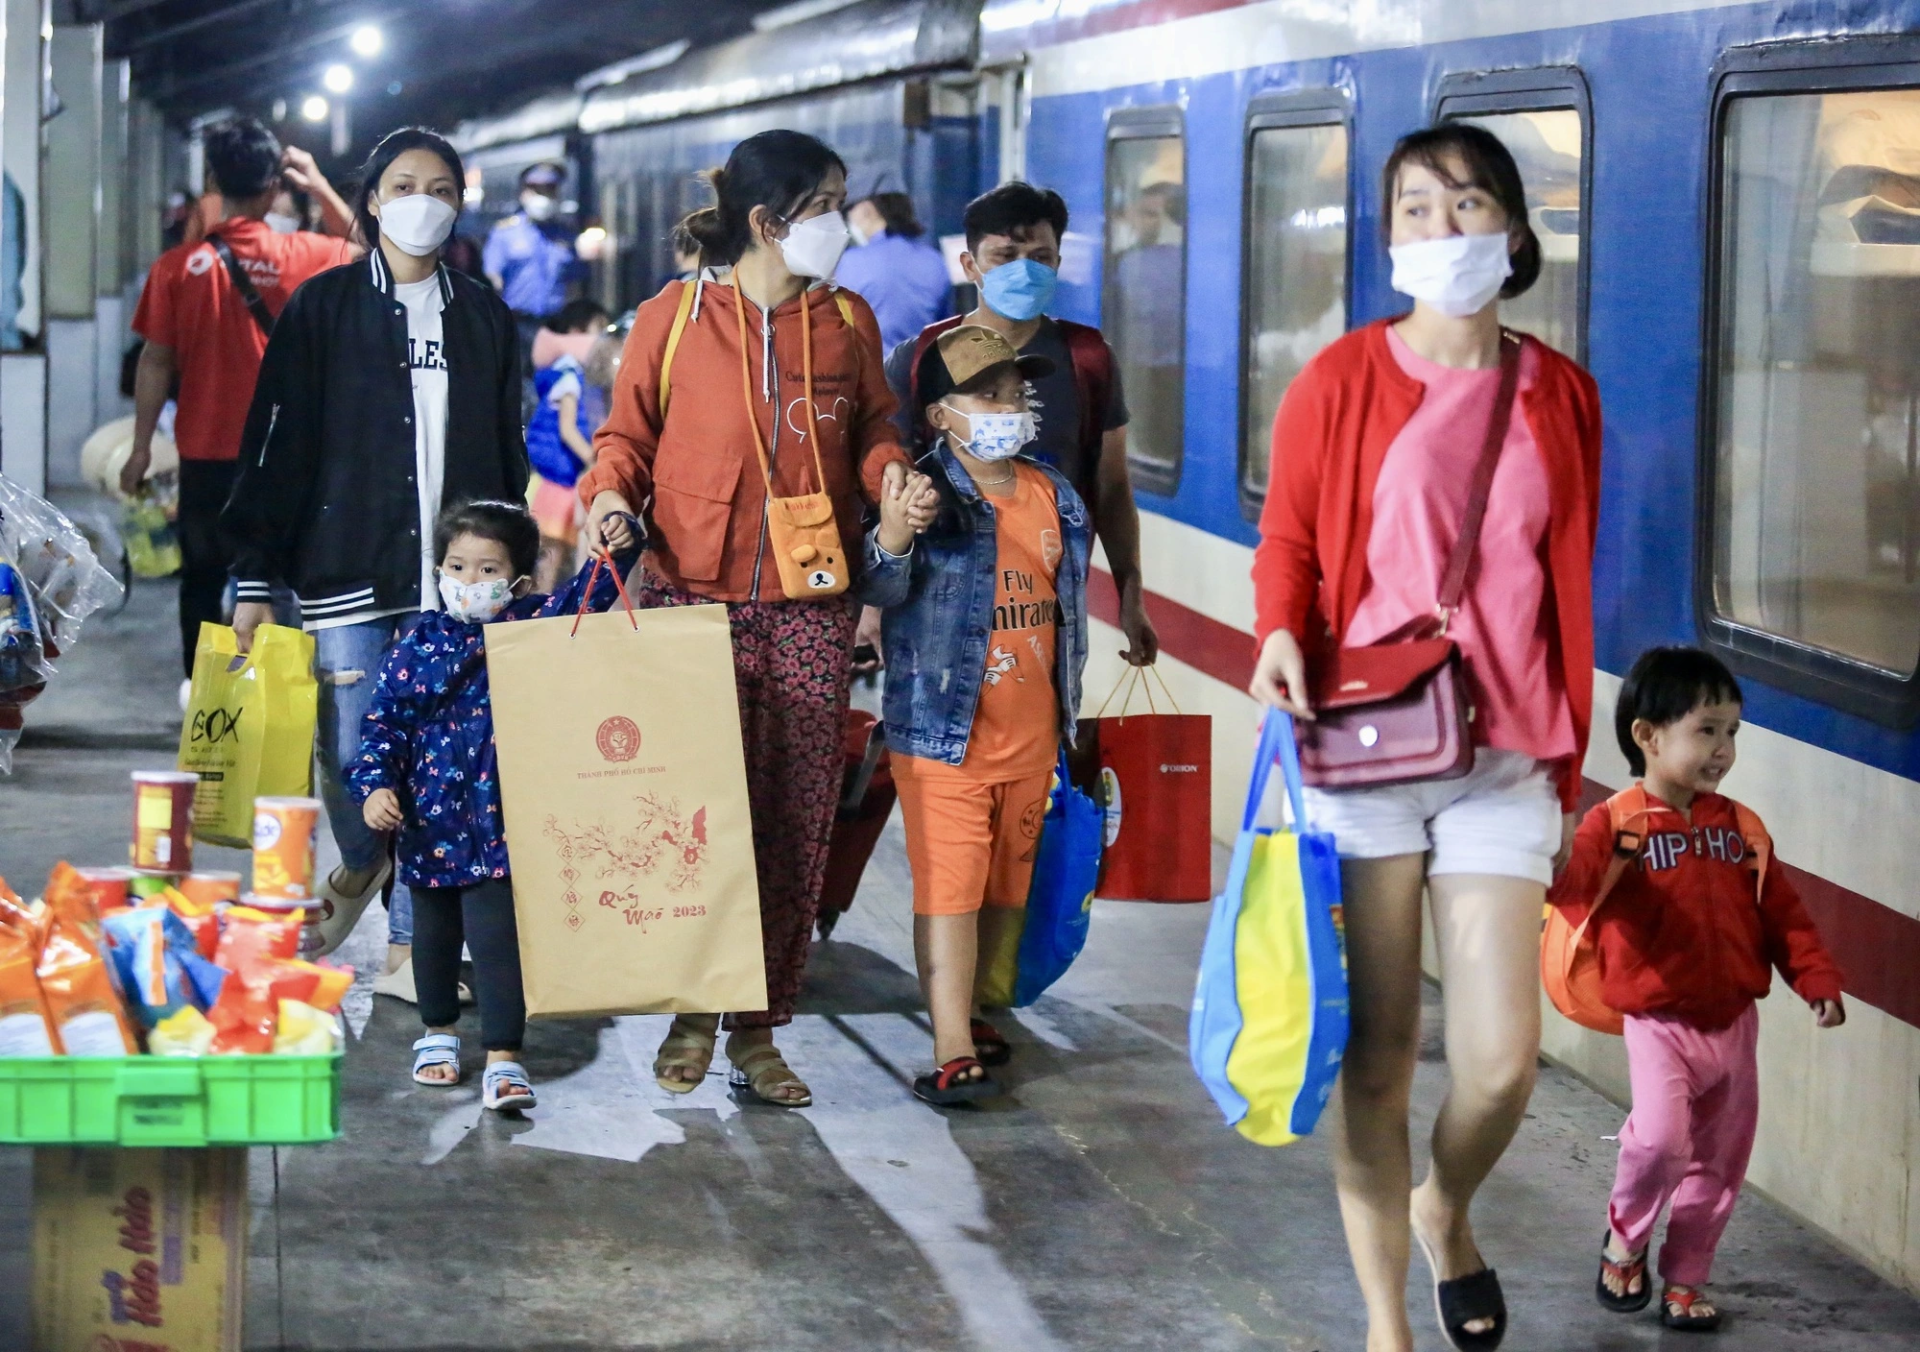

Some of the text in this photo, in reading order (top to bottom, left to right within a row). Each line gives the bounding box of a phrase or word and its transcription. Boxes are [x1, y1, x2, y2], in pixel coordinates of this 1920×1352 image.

[1003, 570, 1033, 594] Fly
[647, 766, 666, 774] MINH
[1169, 764, 1199, 773] ORION
[1705, 827, 1745, 864] HO
[599, 884, 639, 908] Quý
[673, 905, 707, 918] 2023
